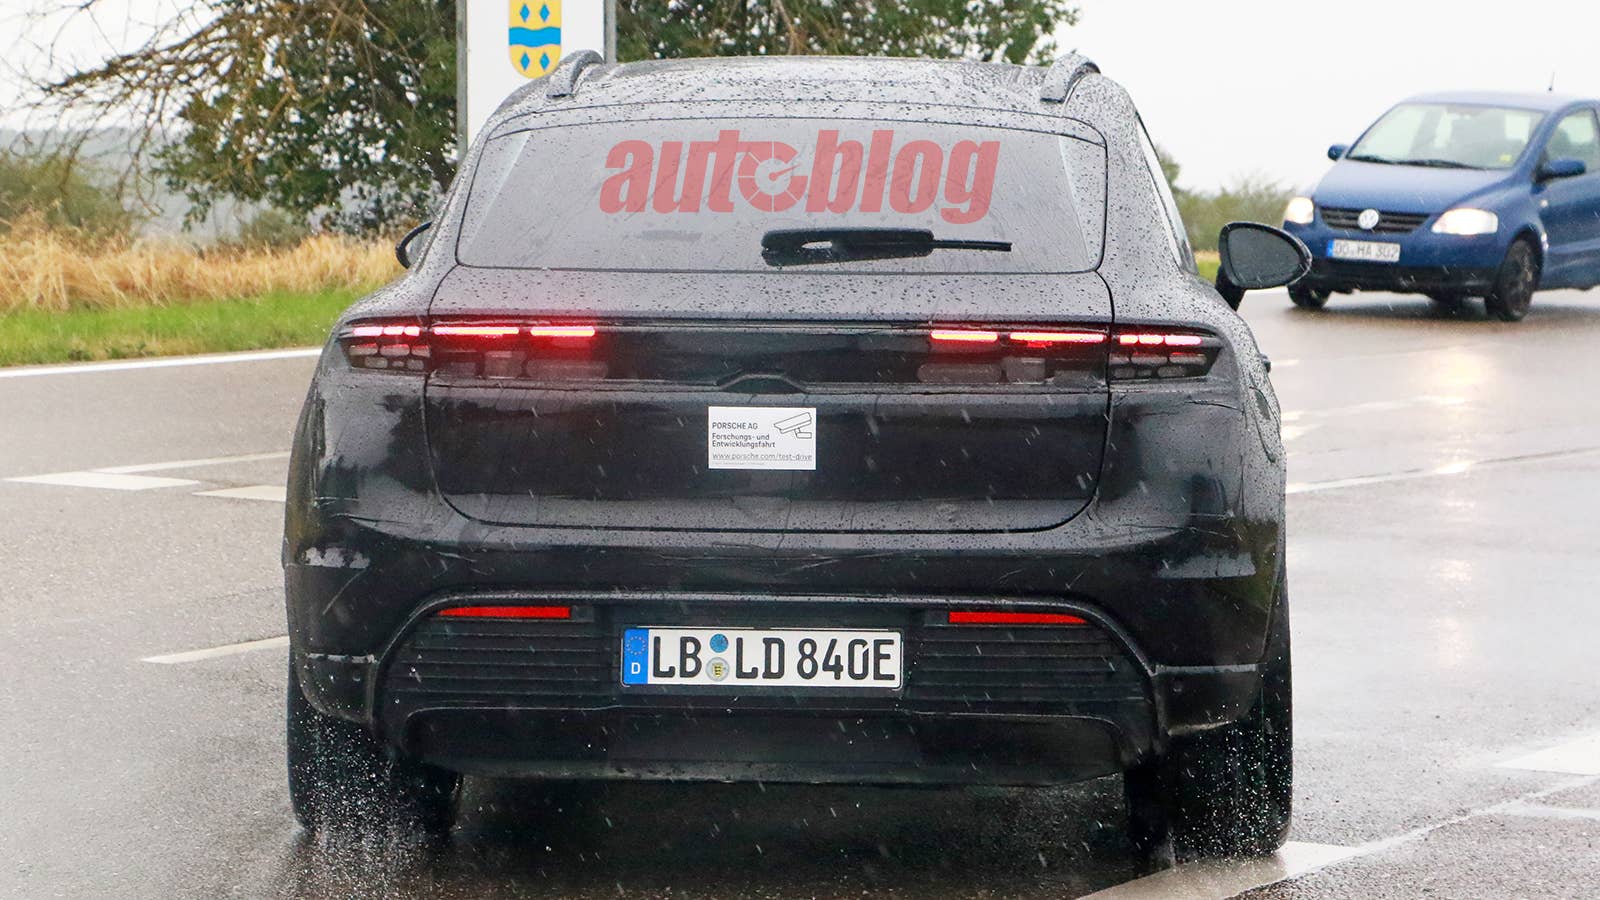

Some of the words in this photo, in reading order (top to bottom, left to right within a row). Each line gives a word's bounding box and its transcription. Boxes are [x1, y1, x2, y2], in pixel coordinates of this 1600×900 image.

[712, 422, 746, 430] PORSCHE
[748, 422, 758, 430] AG
[712, 433, 755, 441] Forschungs-
[712, 440, 776, 449] Entwicklungsfahrt
[712, 453, 813, 462] www.porsche.com/test-drive
[652, 636, 702, 679] LB
[736, 637, 785, 680] LD
[797, 638, 896, 681] 840E
[631, 662, 642, 675] D
